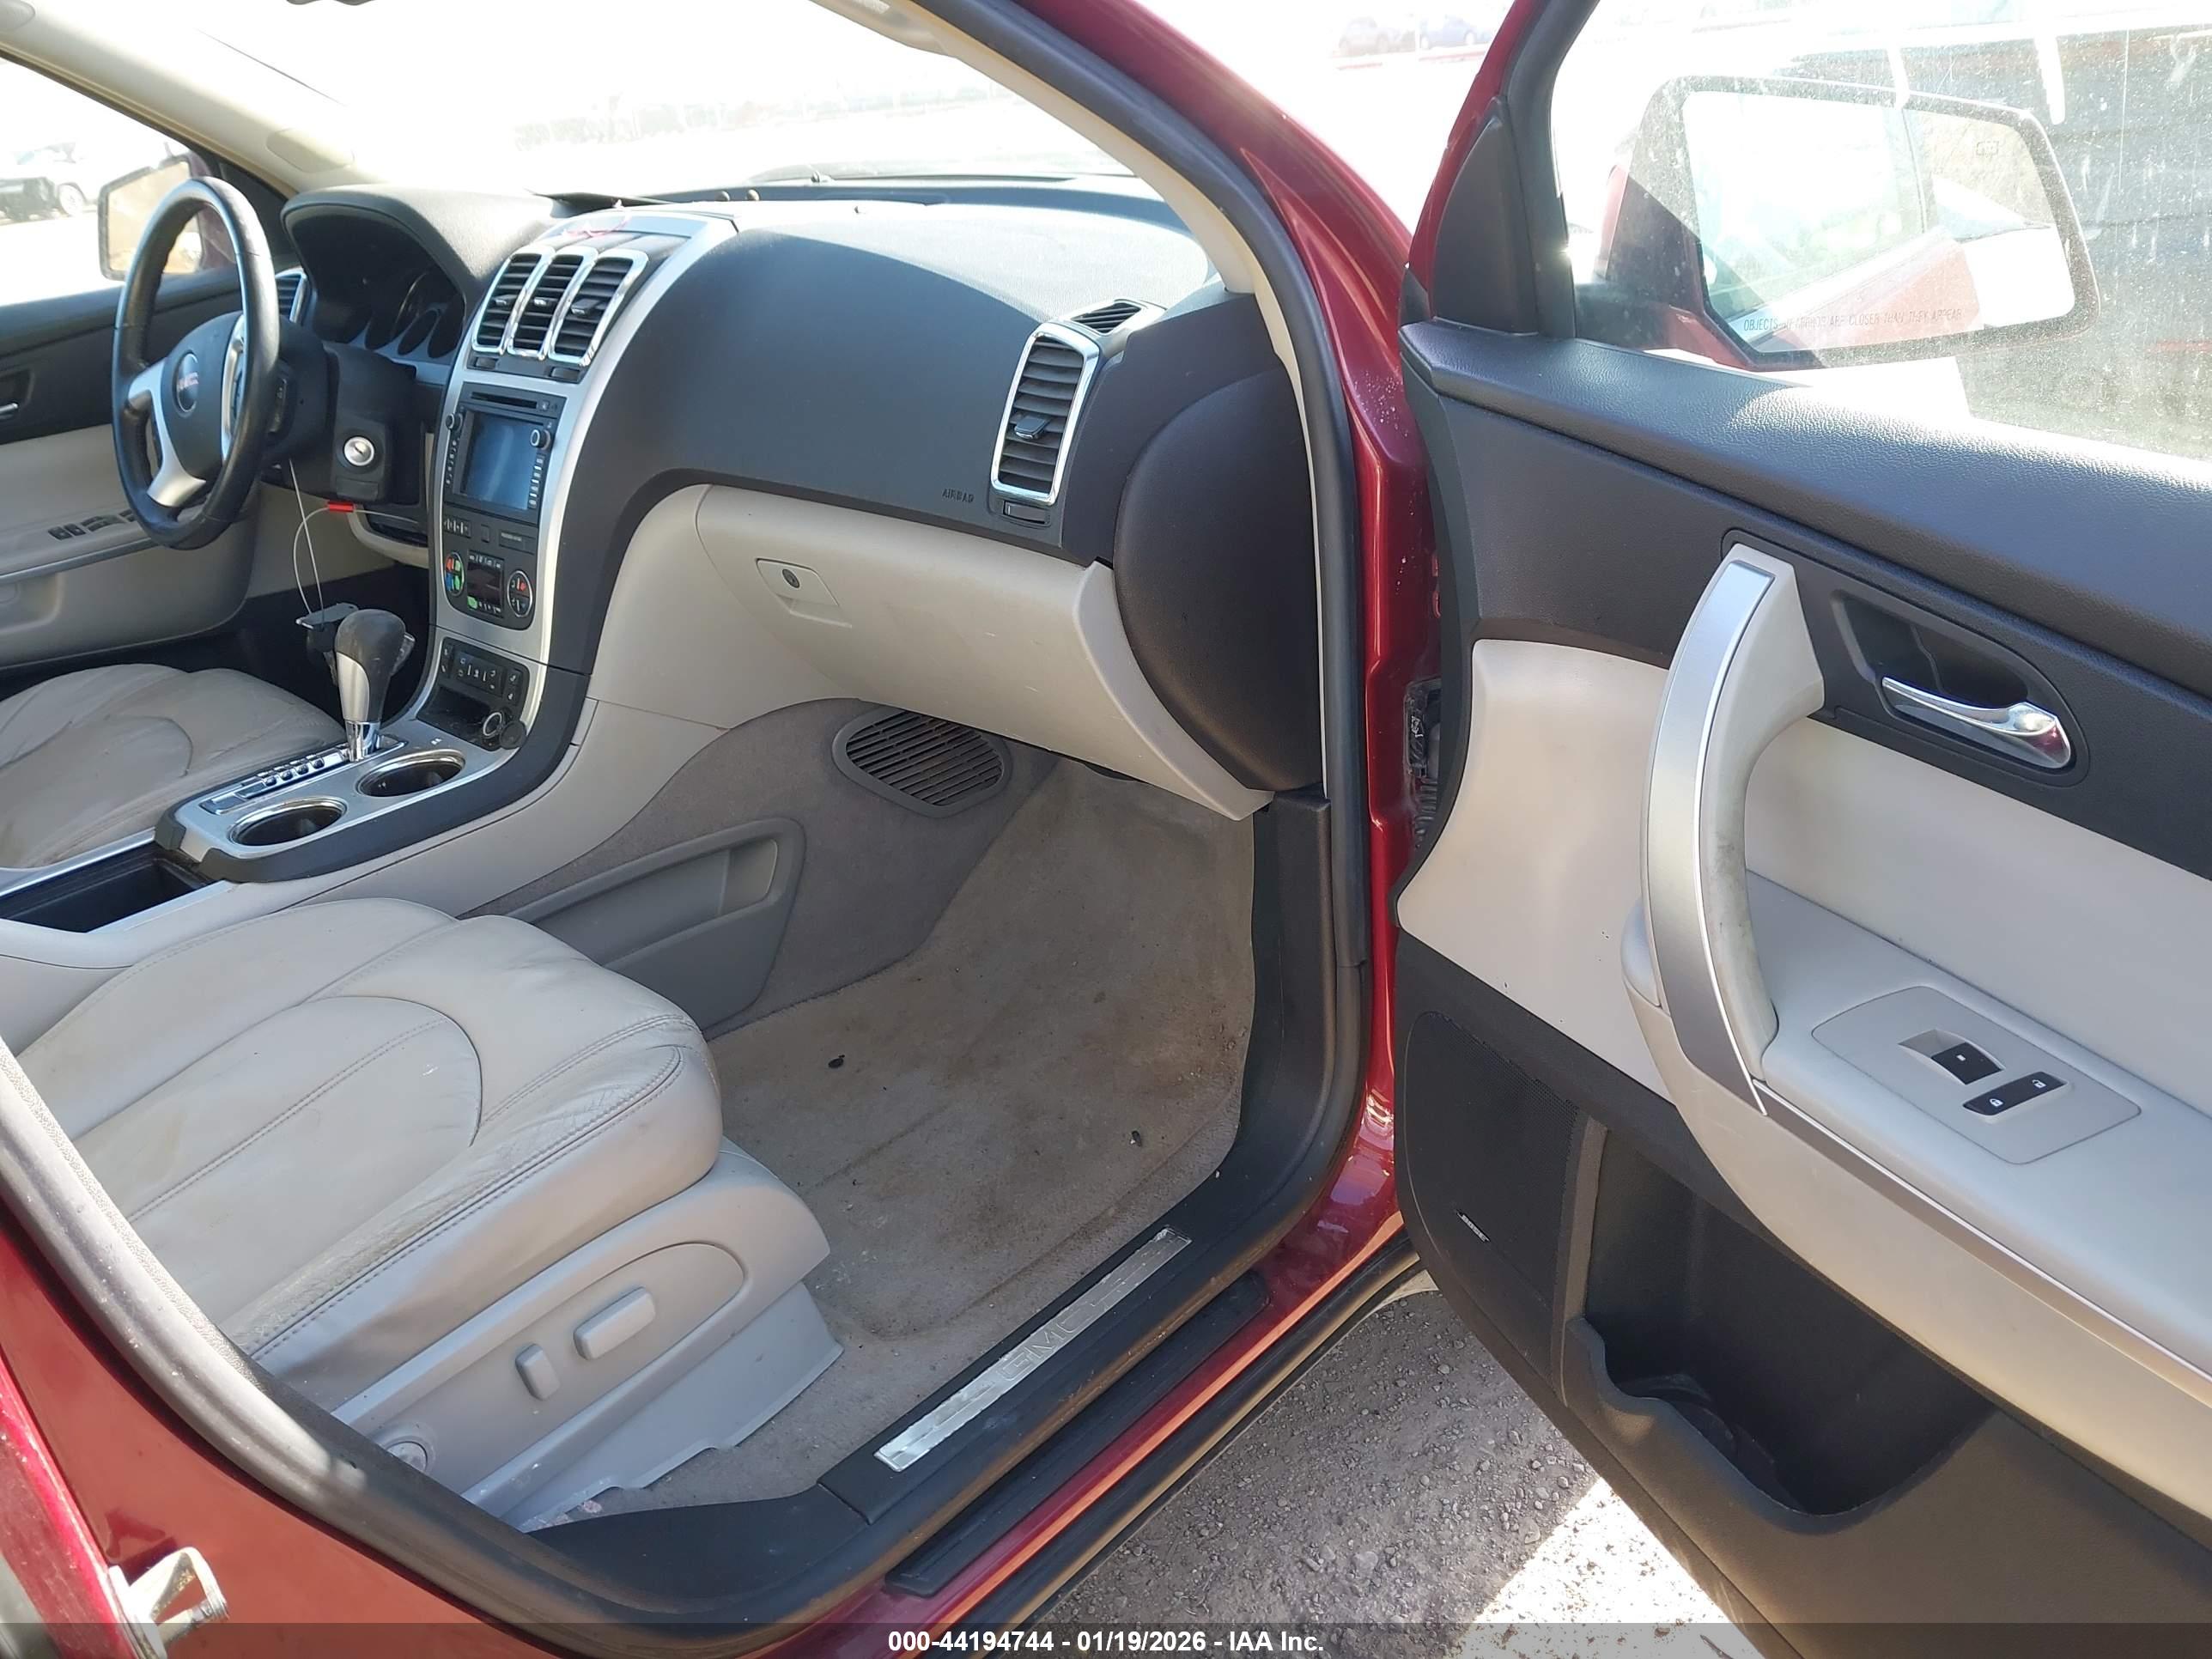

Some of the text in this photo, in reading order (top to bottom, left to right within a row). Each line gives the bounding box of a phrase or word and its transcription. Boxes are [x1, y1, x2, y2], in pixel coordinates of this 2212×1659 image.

[1743, 316, 1778, 331] OBJECTS
[1848, 313, 1880, 326] CLOSER
[996, 1304, 1093, 1382] GMC
